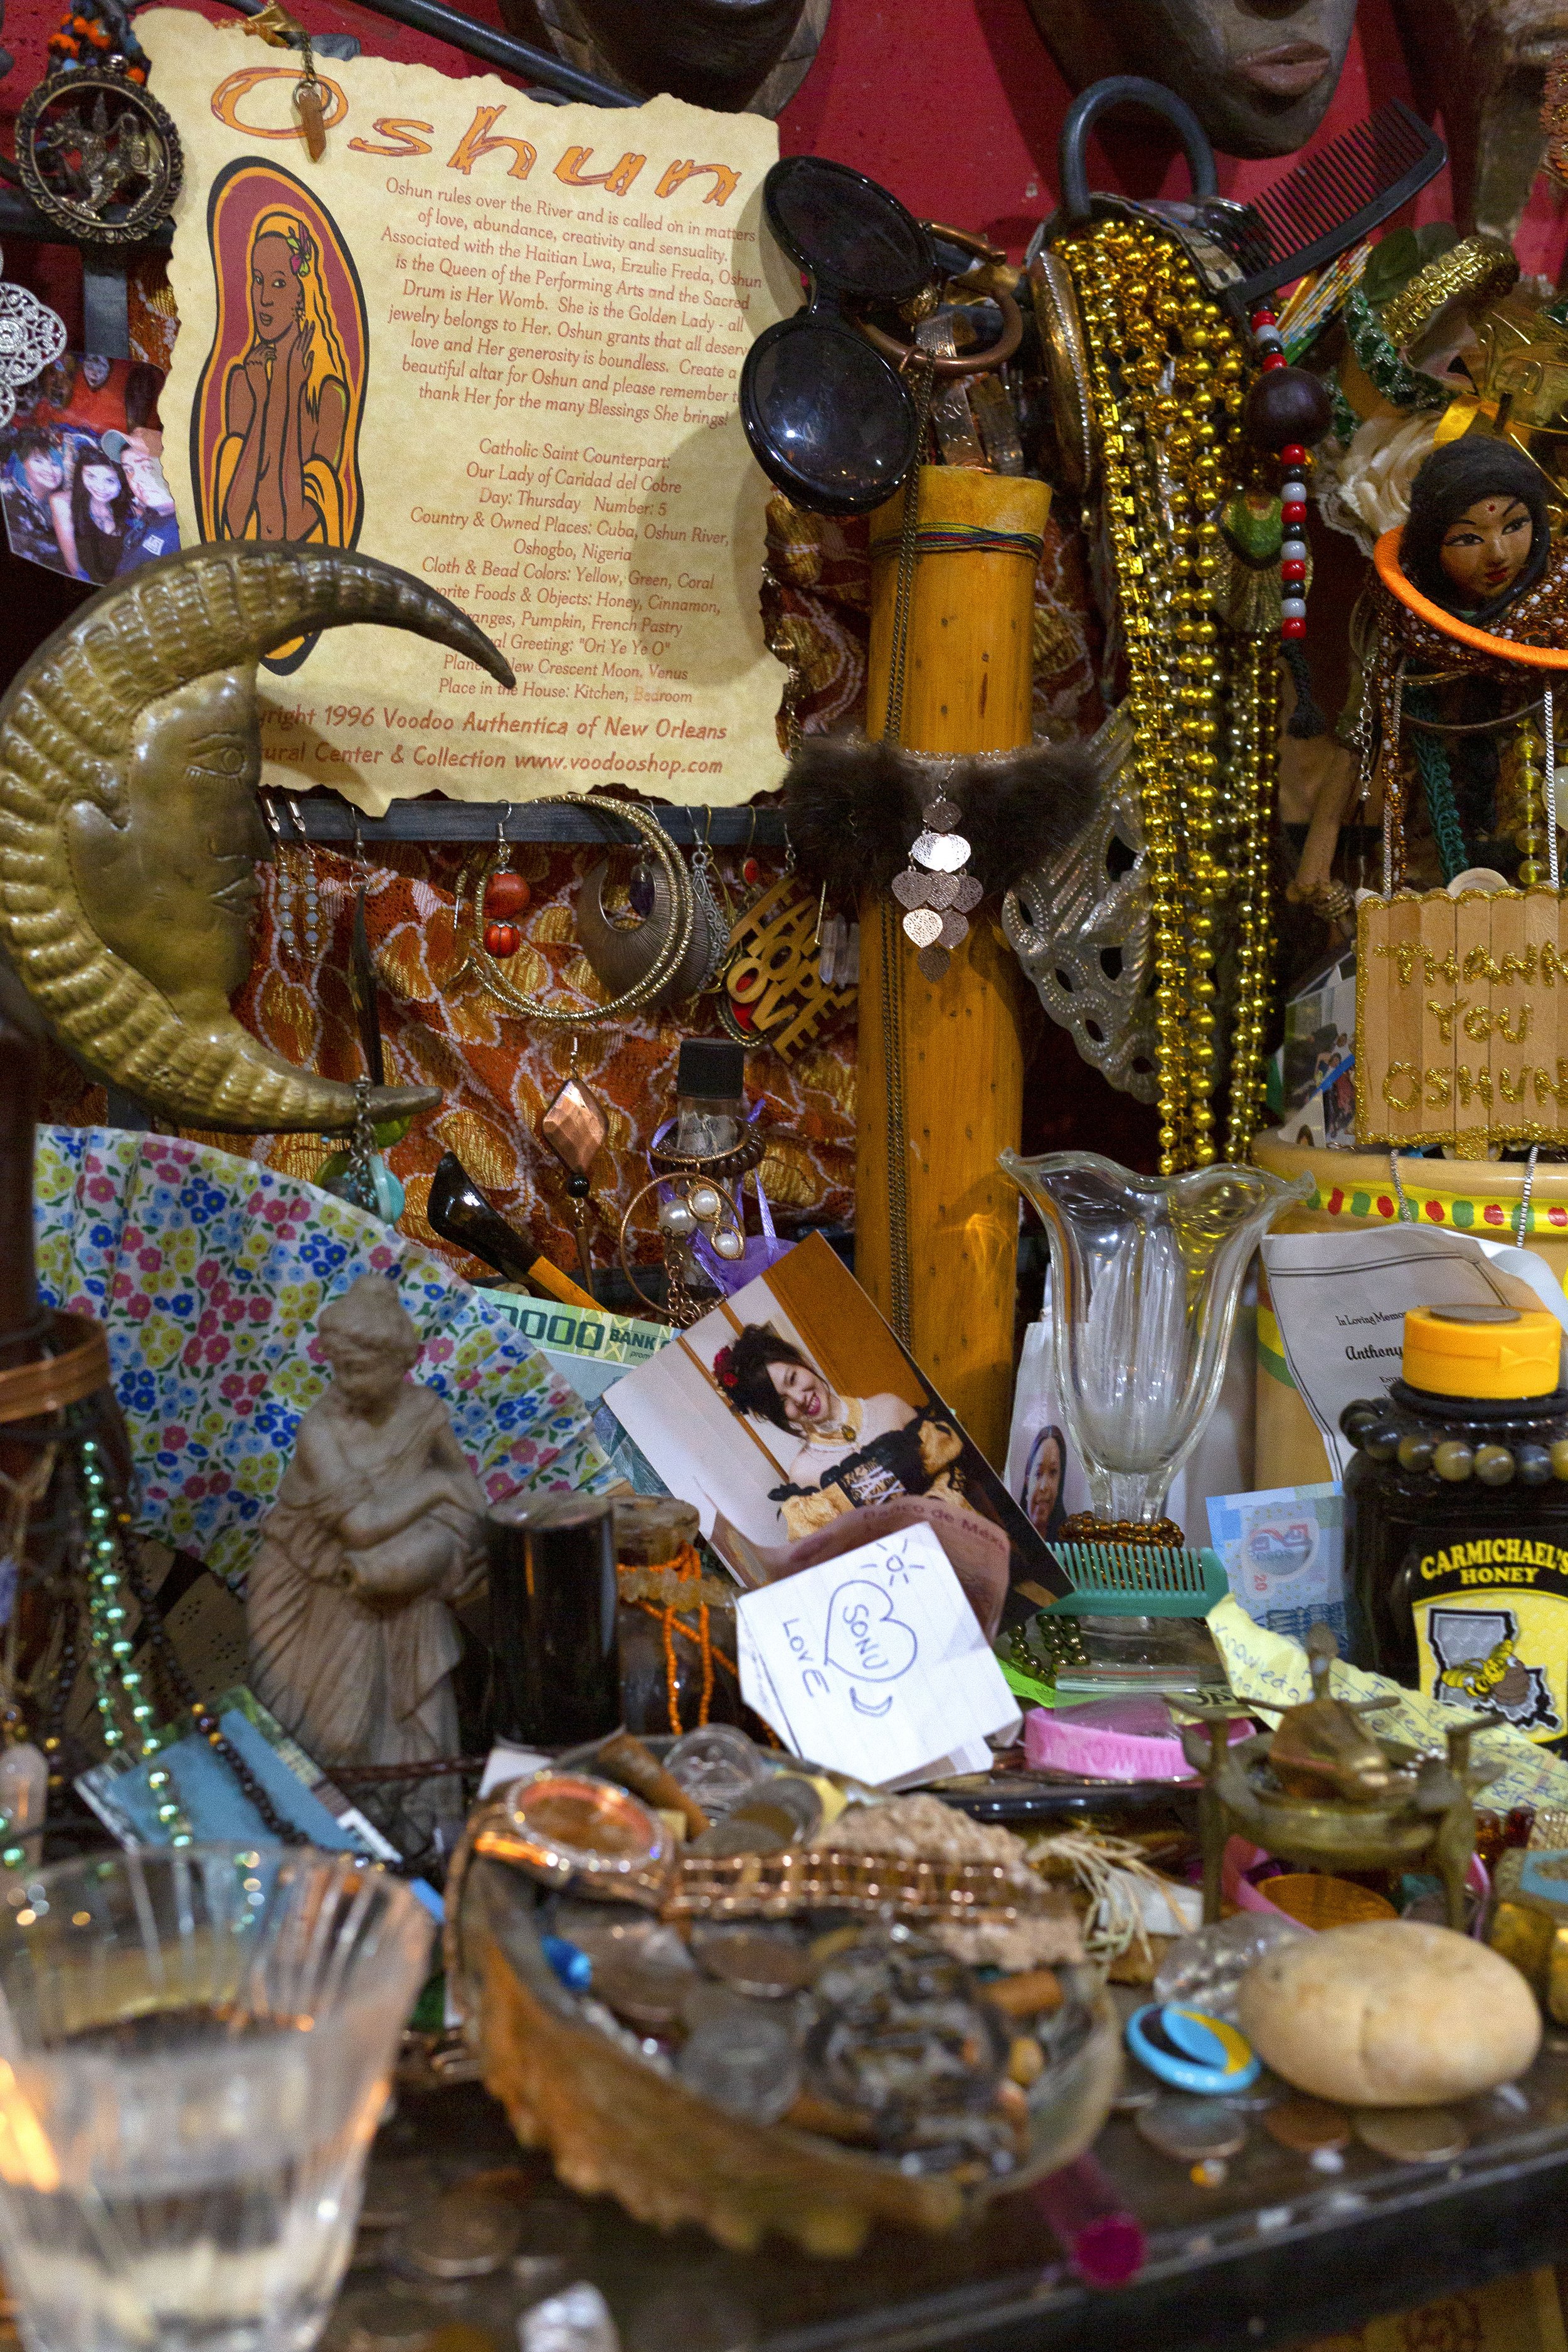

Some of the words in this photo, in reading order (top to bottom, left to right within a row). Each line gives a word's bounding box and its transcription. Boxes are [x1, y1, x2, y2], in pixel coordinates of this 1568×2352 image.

[211, 66, 742, 208] Oshun
[386, 177, 432, 199] Oshun
[438, 186, 471, 205] rules
[475, 197, 506, 209] over
[511, 195, 531, 213] the
[536, 199, 573, 218] River
[576, 207, 603, 223] and
[608, 211, 618, 225] is
[623, 213, 662, 230] called
[667, 220, 683, 232] on
[688, 221, 699, 235] in
[704, 226, 756, 241] matters
[380, 225, 460, 250] Associated
[464, 238, 494, 255] with
[499, 240, 521, 258] the
[525, 244, 577, 265] Haitian
[582, 252, 615, 273] Lwa,
[621, 257, 667, 276] Erzulie
[672, 263, 713, 284] Freda,
[719, 270, 761, 287] Oshun
[418, 206, 433, 227] of
[435, 208, 467, 230] love,
[473, 215, 556, 241] abundance,
[562, 231, 624, 252] creativity
[628, 237, 654, 252] and
[659, 244, 728, 266] sensuality.
[395, 253, 406, 269] is
[412, 253, 434, 272] the
[439, 258, 486, 277] Queen
[491, 263, 507, 285] of
[509, 266, 531, 283] the
[535, 269, 612, 297] Performing
[615, 280, 644, 297] Arts
[649, 285, 674, 300] and
[679, 287, 699, 304] the
[703, 290, 750, 309] Sacred
[402, 278, 445, 299] Drum
[450, 285, 462, 300] is
[466, 286, 494, 303] Her
[499, 289, 548, 310] Womb.
[558, 296, 583, 314] She
[588, 301, 598, 316] is
[603, 301, 623, 319] the
[628, 305, 676, 324] Golden
[681, 311, 714, 332] Lady
[728, 317, 743, 332] all
[387, 304, 439, 328] jewelry
[443, 307, 498, 334] belongs
[503, 319, 516, 331] to
[521, 317, 551, 335] Her.
[557, 320, 601, 340] Oshun
[606, 332, 650, 346] grants
[654, 331, 681, 349] that
[685, 336, 701, 351] all
[411, 329, 439, 349] love
[443, 336, 472, 352] and
[477, 338, 504, 355] Her
[507, 347, 580, 367] generosity
[583, 350, 593, 364] is
[598, 349, 669, 372] boundless.
[679, 358, 724, 377] Create
[402, 354, 465, 381] beautiful
[469, 362, 503, 381] altar
[506, 364, 527, 386] for
[531, 368, 577, 387] Oshun
[581, 374, 610, 391] and
[613, 376, 655, 395] please
[660, 384, 728, 401] remember
[419, 381, 459, 401] thank
[464, 386, 490, 404] Her
[493, 388, 515, 410] for
[519, 391, 541, 409] the
[545, 400, 585, 416] many
[588, 398, 649, 423] Blessings
[654, 405, 678, 421] She
[683, 406, 729, 429] brings!
[479, 438, 538, 457] Catholic
[542, 443, 579, 461] Saint
[583, 447, 670, 470] Counterpart:
[466, 461, 494, 478] Our
[499, 464, 534, 485] Lady
[538, 467, 553, 487] of
[554, 469, 612, 488] Caridad
[616, 473, 637, 489] del
[641, 476, 681, 493] Cobre
[479, 487, 512, 508] Day:
[517, 489, 580, 514] Thursday
[593, 495, 655, 516] Number:
[410, 506, 469, 529] Country
[472, 511, 484, 527] &
[490, 512, 541, 531] Owned
[544, 516, 591, 534] Places:
[596, 519, 637, 539] Cuba,
[644, 524, 686, 541] Oshun
[691, 527, 729, 546] River,
[513, 538, 576, 560] Oshogbo,
[582, 543, 631, 563] Nigeria
[421, 556, 460, 573] Cloth
[464, 559, 476, 575] &
[481, 560, 519, 577] Bead
[523, 563, 571, 580] Colors:
[576, 566, 622, 586] Yellow,
[628, 569, 671, 588] Green,
[677, 572, 714, 588] Coral
[474, 583, 516, 601] Foods
[520, 586, 531, 602] &
[537, 587, 591, 608] Objects:
[596, 591, 642, 612] Honey,
[648, 594, 720, 615] Cinnamon,
[521, 610, 585, 632] Pumpkin,
[591, 613, 637, 630] French
[641, 617, 682, 634] Pastry
[511, 633, 573, 655] Greeting:
[579, 637, 605, 652] "Ori
[611, 638, 627, 654] Ye
[632, 640, 647, 654] Ye
[652, 641, 670, 655] O"
[538, 658, 598, 675] Crescent
[649, 664, 687, 679] Venus
[438, 677, 475, 694] Place
[480, 681, 492, 694] in
[522, 681, 569, 697] House:
[573, 683, 627, 702] Kitchen,
[633, 687, 692, 703] Bedroom
[325, 705, 374, 726] 1996
[383, 707, 453, 730] Voodoo
[462, 711, 568, 735] Authentica
[576, 715, 601, 738] of
[655, 718, 726, 739] Orleans
[315, 739, 383, 764] Center
[390, 744, 403, 763] &
[413, 745, 506, 768] Collection
[515, 751, 723, 779] www.voodooshop.com
[1427, 997, 1534, 1046] YOU
[1382, 1056, 1568, 1113] OSHUN
[609, 1326, 657, 1350] BANK
[1335, 1315, 1347, 1327] In
[1344, 1314, 1377, 1326] Loving
[1345, 1343, 1404, 1361] Anthony
[1420, 1538, 1568, 1581] CARMICHAEL'S
[1459, 1567, 1540, 1585] HONEY
[781, 1616, 830, 1698] LOVE
